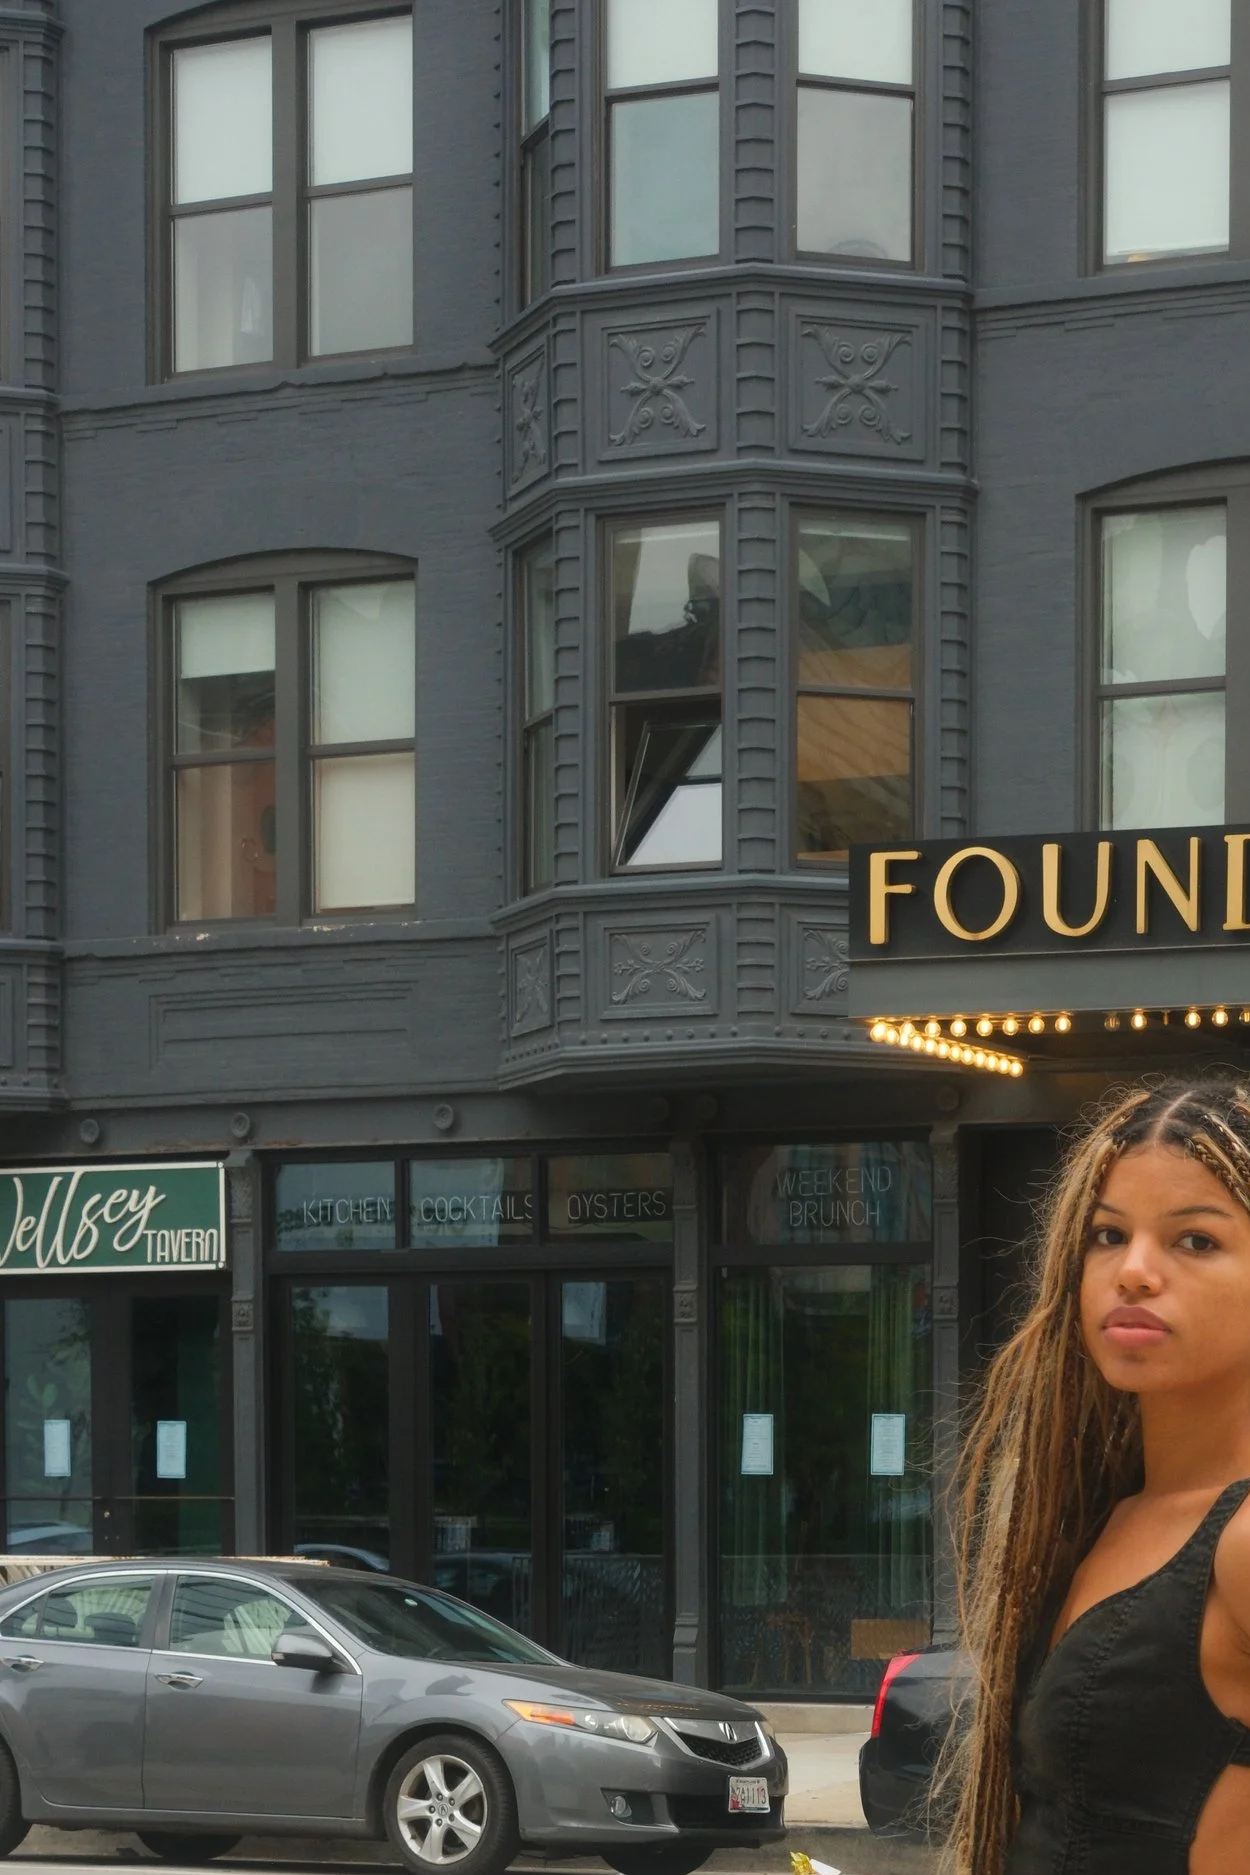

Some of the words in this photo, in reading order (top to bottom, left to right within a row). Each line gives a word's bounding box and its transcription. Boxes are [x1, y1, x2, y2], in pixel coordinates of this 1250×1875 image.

[775, 1166, 892, 1197] WEEKEND
[303, 1197, 391, 1224] KITCHEN
[420, 1194, 533, 1222] COCKTAILS
[567, 1191, 666, 1220] OYSTERS
[789, 1200, 880, 1226] BRUNCH
[143, 1228, 218, 1263] TAVERN
